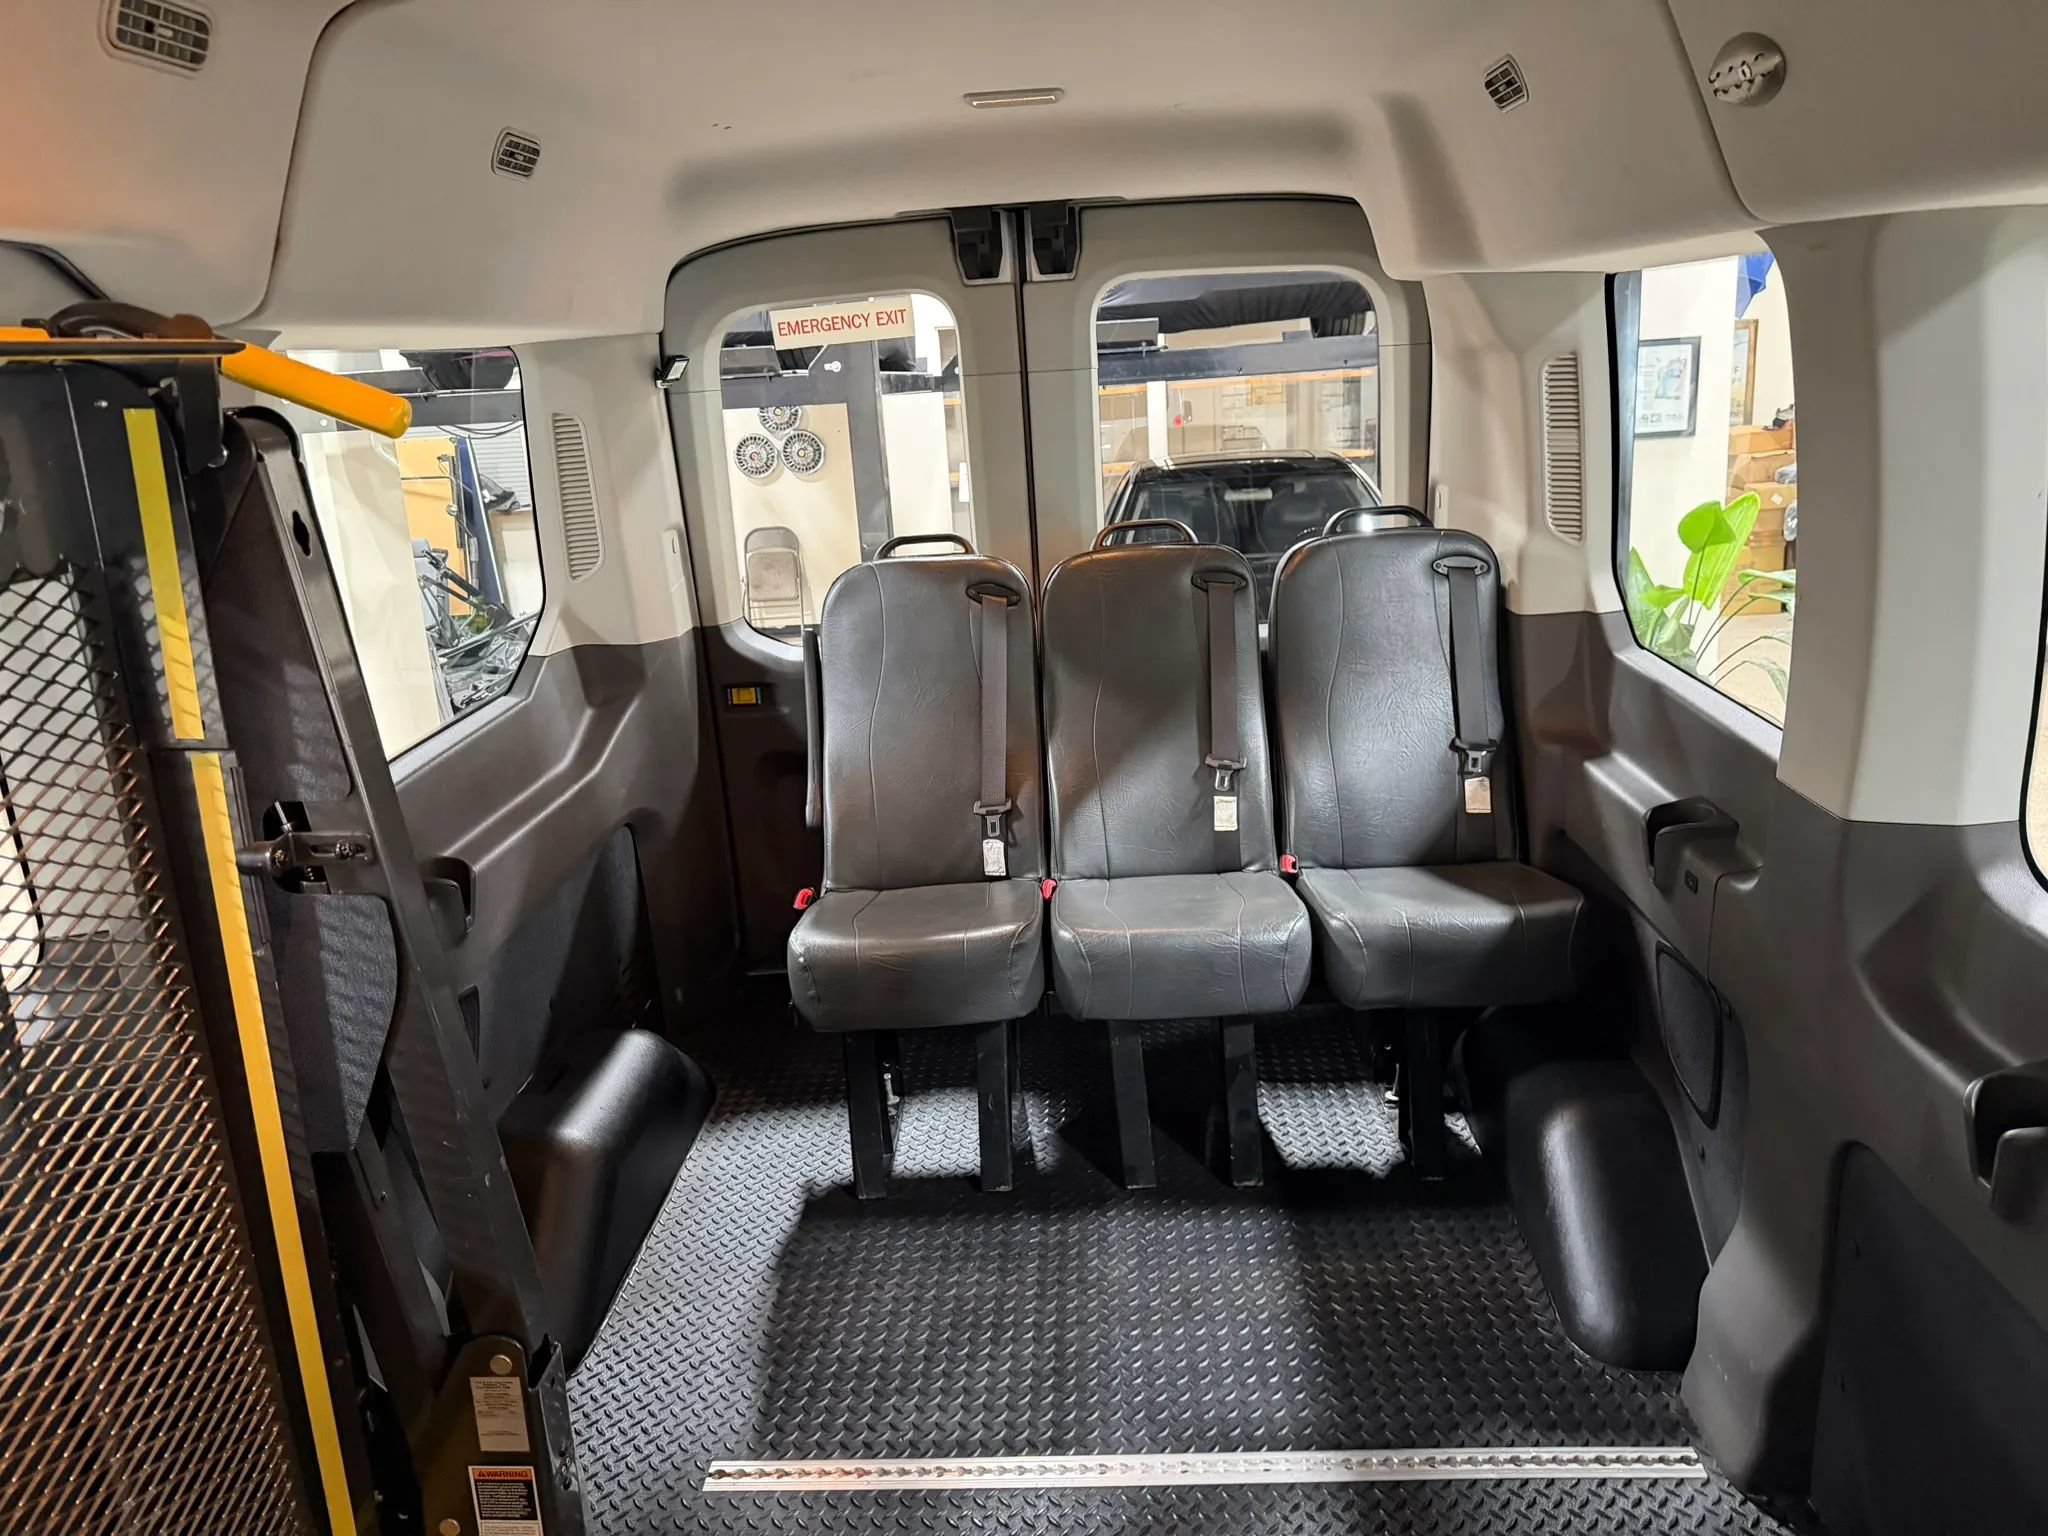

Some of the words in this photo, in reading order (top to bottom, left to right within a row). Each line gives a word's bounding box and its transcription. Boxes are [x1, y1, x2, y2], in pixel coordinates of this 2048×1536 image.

[777, 313, 871, 337] EMERGENCY
[875, 308, 907, 327] EXIT
[486, 1470, 529, 1478] WARNING
